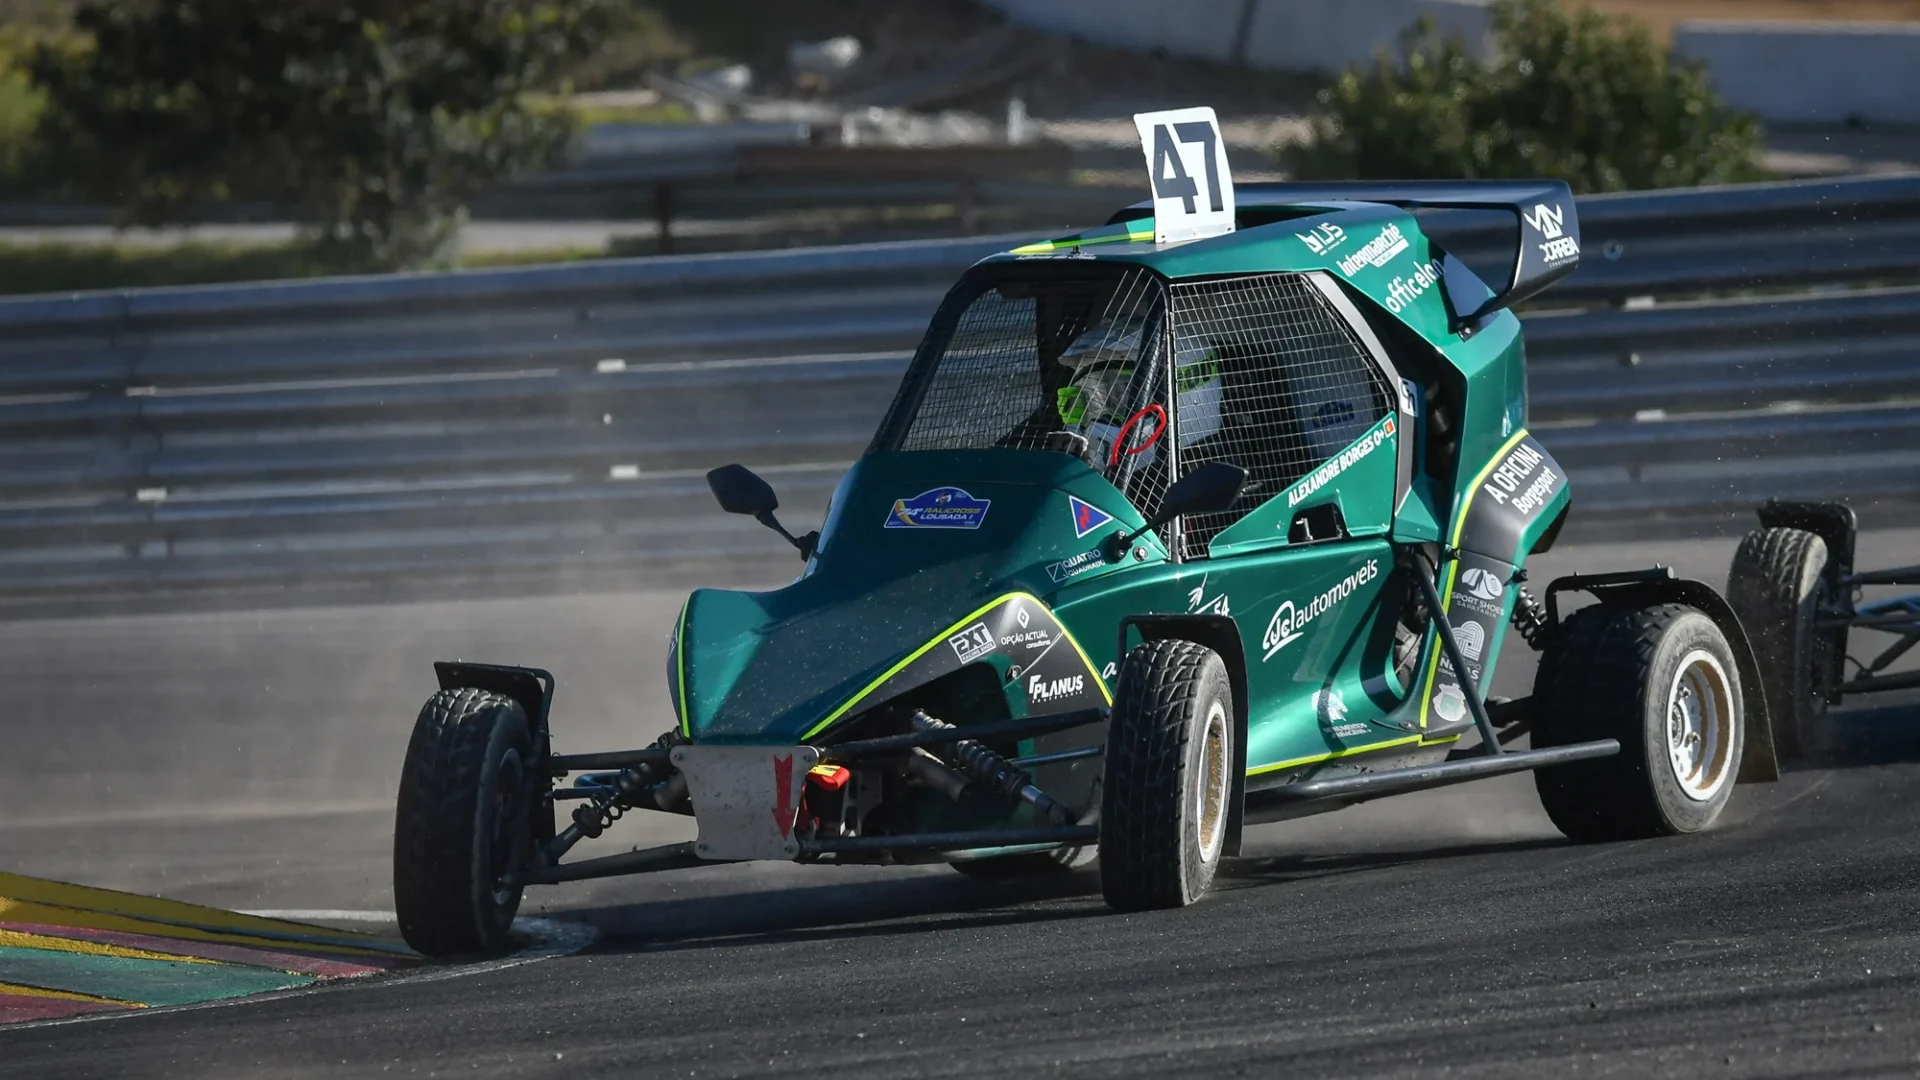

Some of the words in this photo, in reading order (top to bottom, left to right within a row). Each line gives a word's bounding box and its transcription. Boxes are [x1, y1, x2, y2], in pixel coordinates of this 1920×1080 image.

[1152, 121, 1224, 214] 47
[1288, 459, 1341, 508] ALEXANDRE
[1339, 435, 1374, 472] BORGES
[1492, 443, 1544, 492] OFICINA
[1483, 483, 1509, 505] A
[1511, 465, 1558, 515] Borgesport
[923, 507, 981, 515] RALICROSS
[1062, 549, 1101, 568] QUATRO
[1068, 559, 1106, 577] QUADRADO
[1451, 591, 1479, 606] SPORT
[1479, 600, 1505, 616] SHOES
[1456, 600, 1497, 618] SAPATARIA
[1001, 632, 1024, 645] OPÇÃO
[1025, 629, 1049, 642] ACTUAL
